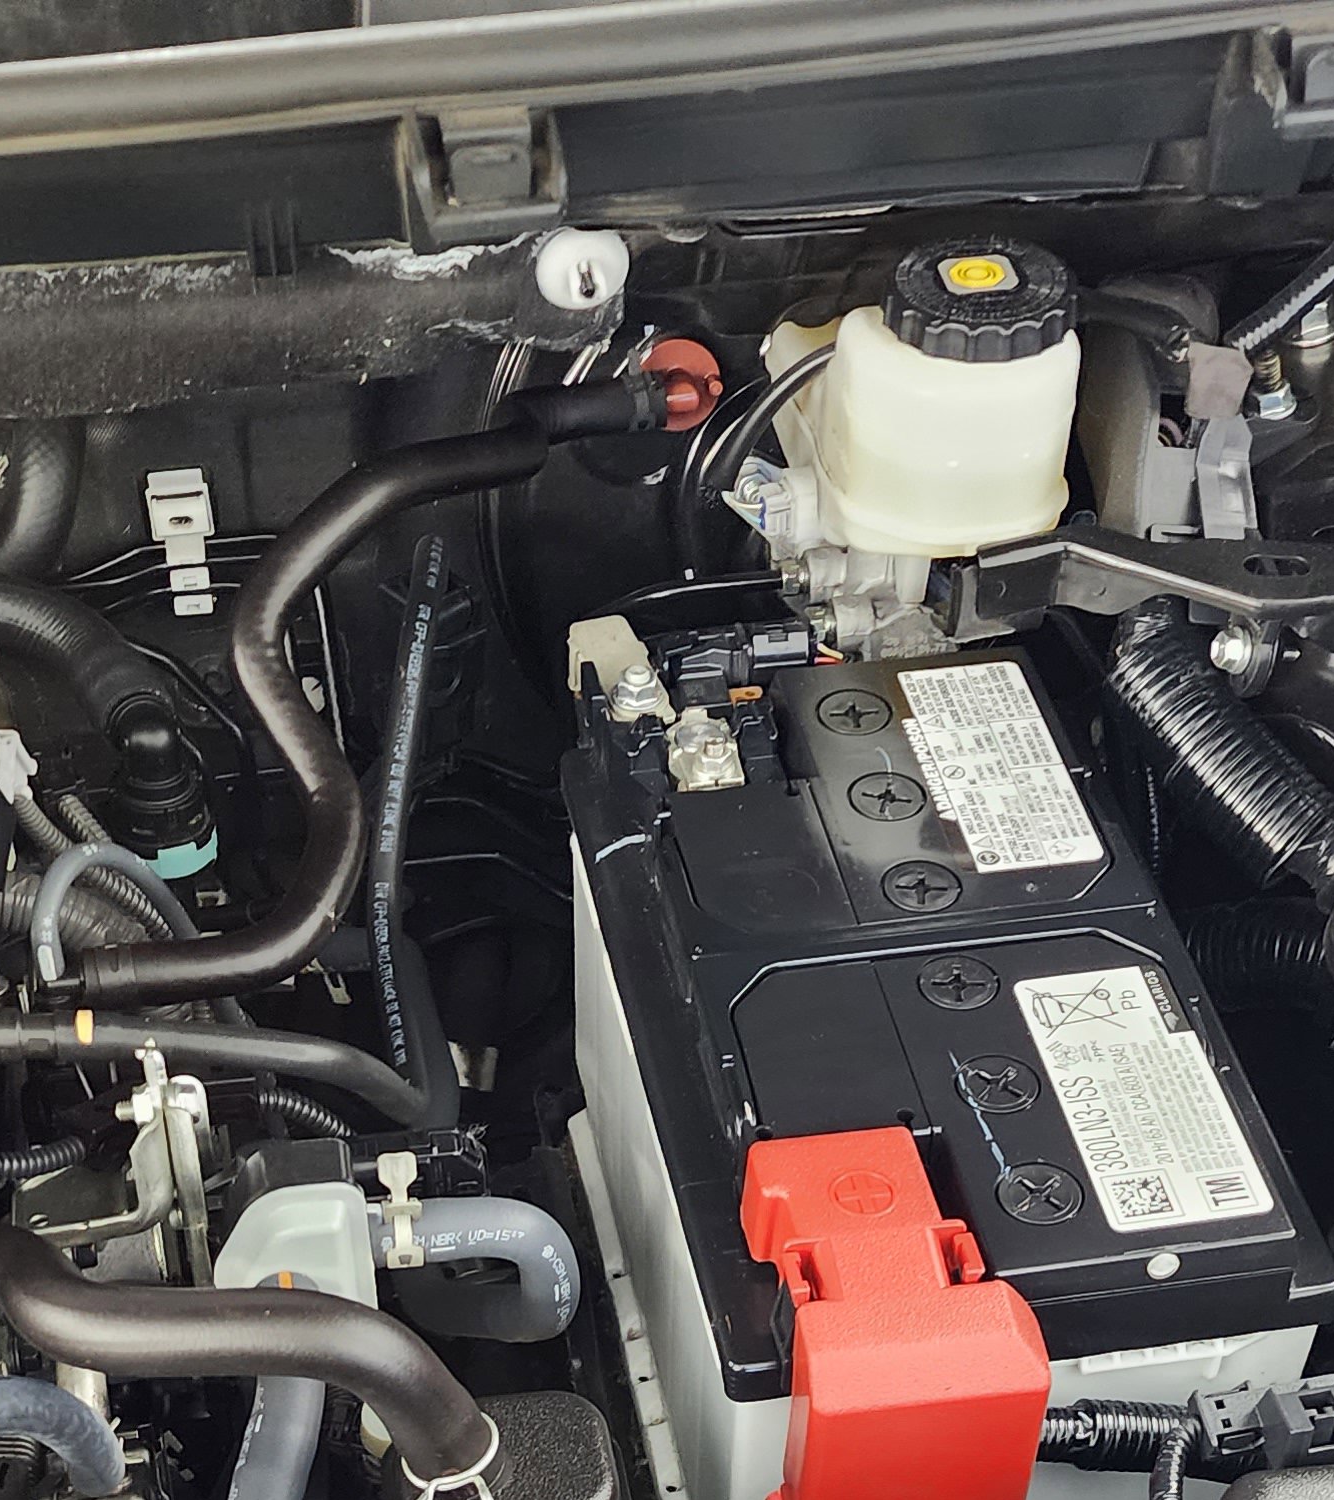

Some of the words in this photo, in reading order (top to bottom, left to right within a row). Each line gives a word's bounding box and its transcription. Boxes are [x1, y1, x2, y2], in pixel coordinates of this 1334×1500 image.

[902, 719, 950, 811] DANGER/POISON
[1120, 989, 1143, 1011] Pb
[1144, 970, 1173, 1013] CLARIOS
[1107, 1042, 1133, 1066] (SAE)
[1117, 1066, 1133, 1075] A
[1120, 1074, 1141, 1092] 603
[1128, 1092, 1150, 1111] CCA
[1058, 1075, 1129, 1173] 380LN3-ISS
[1137, 1114, 1157, 1128] Ah
[1143, 1126, 1162, 1140] 65
[1149, 1140, 1168, 1153] Hr
[1154, 1151, 1174, 1165] 20
[1205, 1176, 1250, 1206] TM
